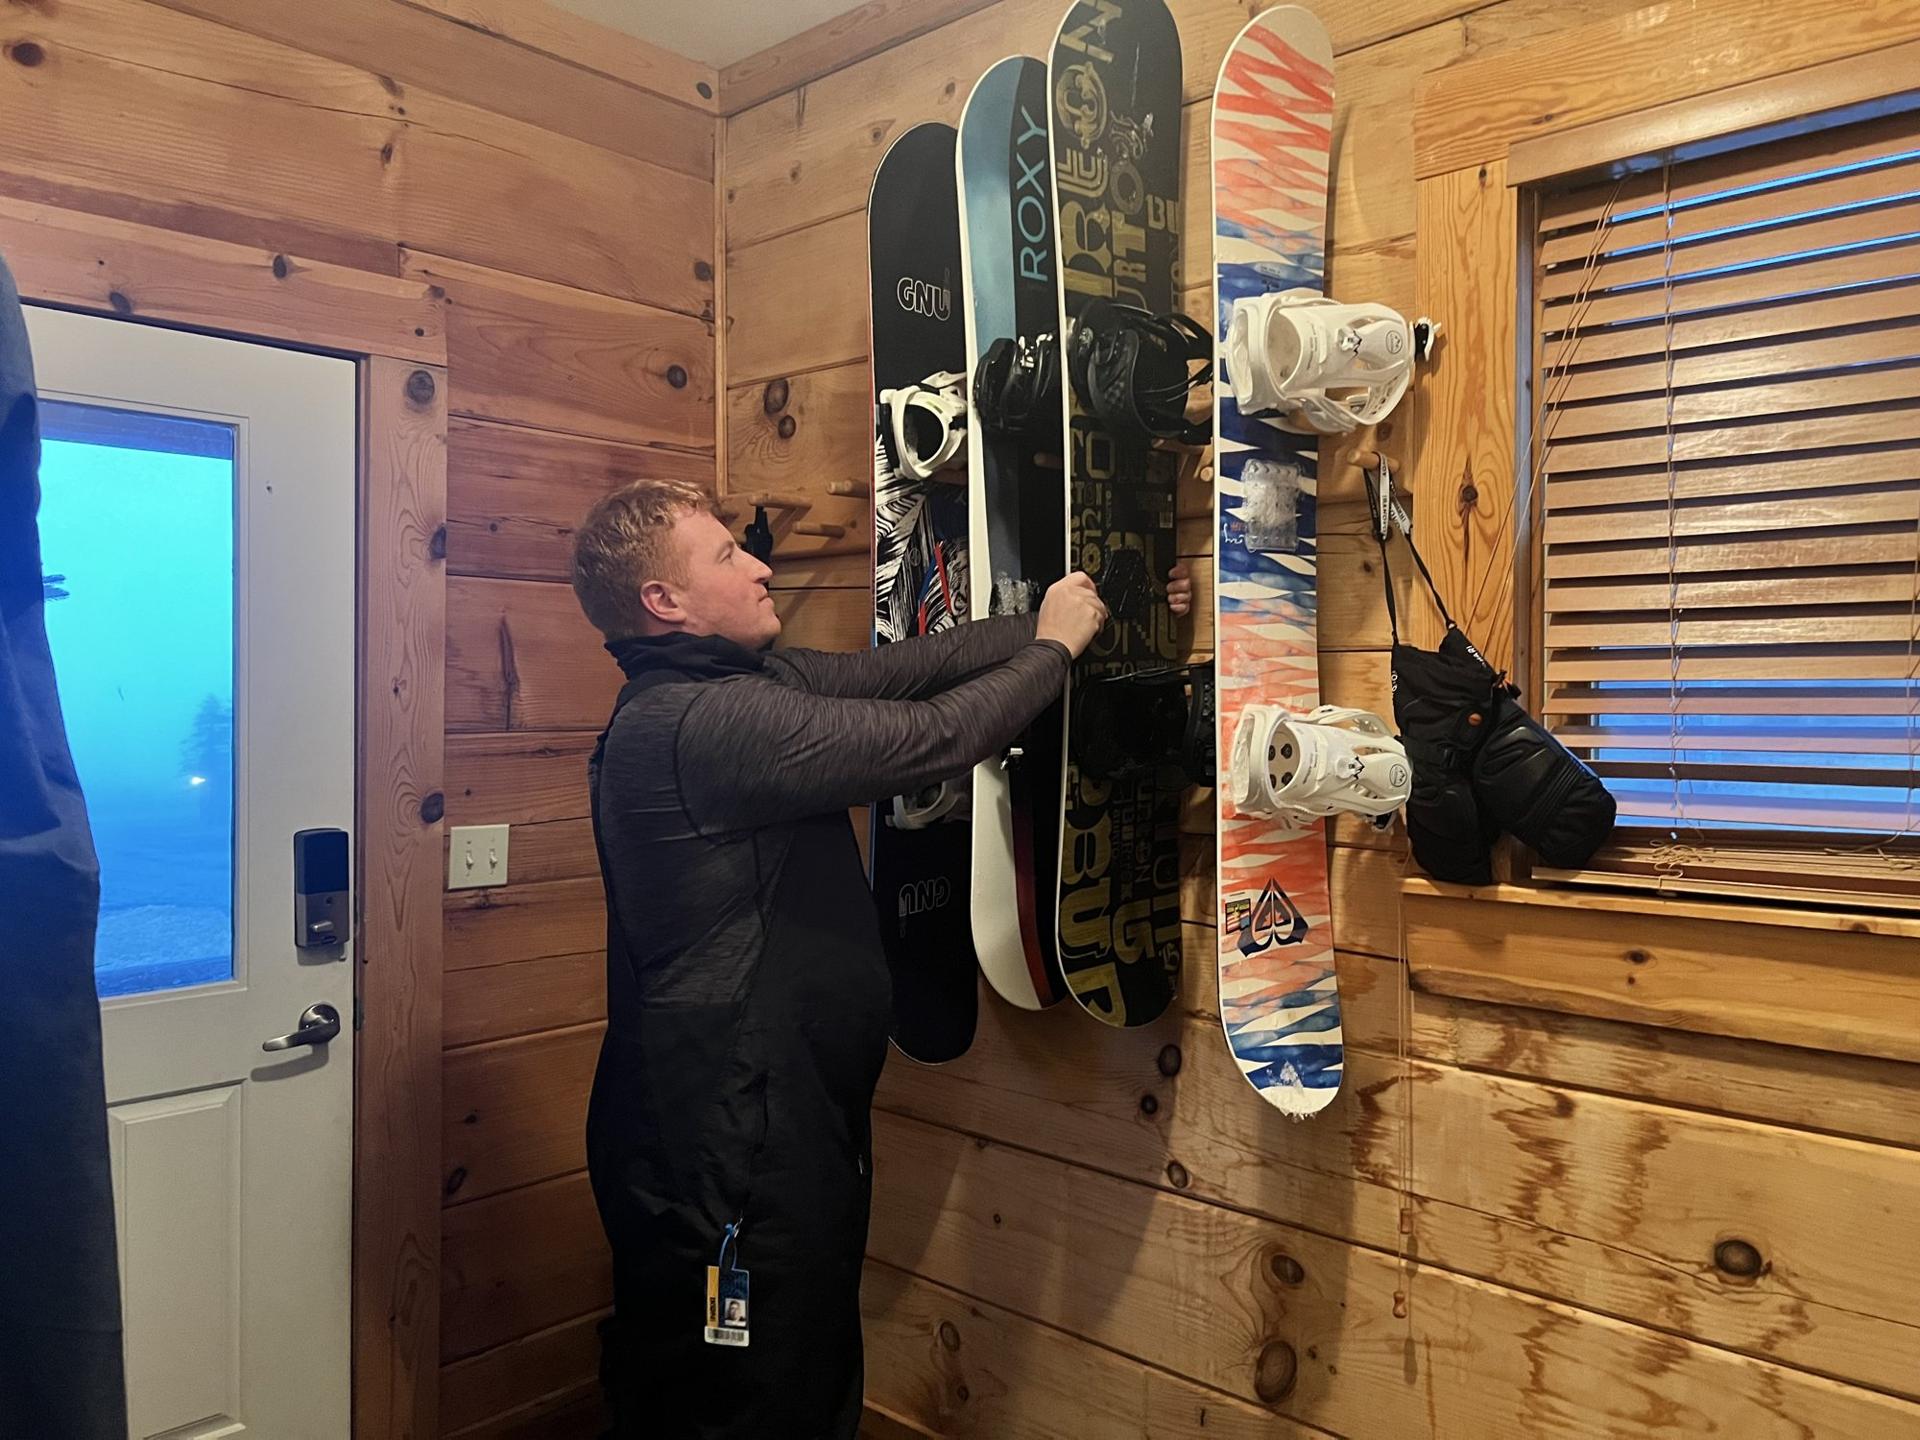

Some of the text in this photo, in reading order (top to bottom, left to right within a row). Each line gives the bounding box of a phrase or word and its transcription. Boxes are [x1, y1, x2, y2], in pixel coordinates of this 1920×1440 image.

[1017, 104, 1048, 282] ROXY
[896, 276, 951, 321] GNU
[898, 876, 952, 918] GNU
